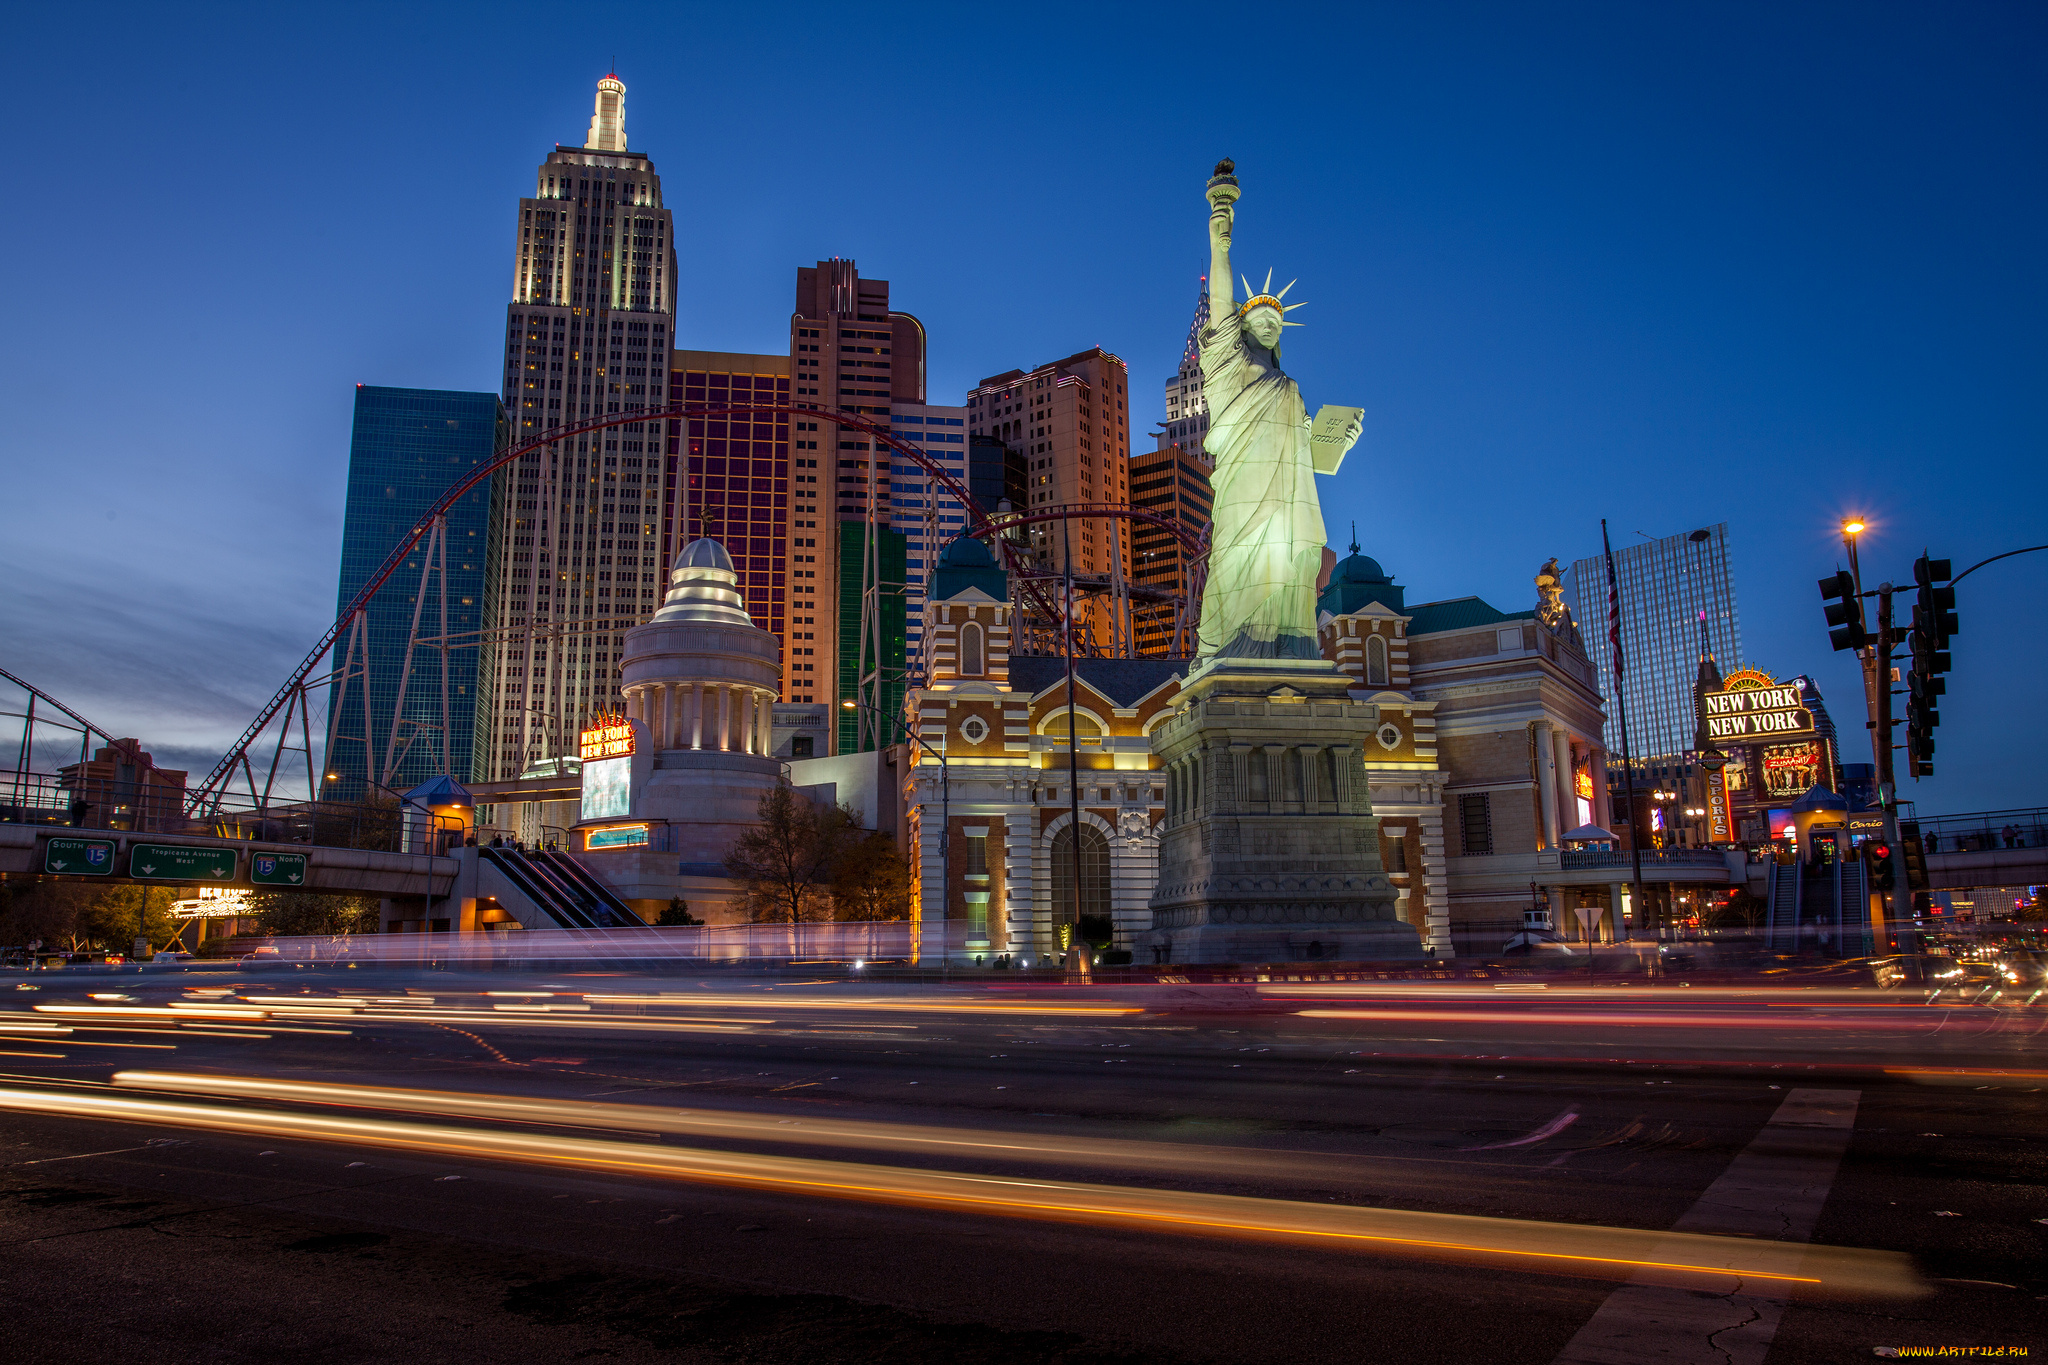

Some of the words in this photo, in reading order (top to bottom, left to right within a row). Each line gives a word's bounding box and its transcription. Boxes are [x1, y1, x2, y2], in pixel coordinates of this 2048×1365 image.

[1706, 693, 1745, 714] NEW
[1748, 688, 1798, 709] YORK
[1708, 716, 1747, 736] NEW
[1751, 711, 1801, 732] YORK
[581, 729, 603, 745] NEW
[603, 724, 630, 741] YORK
[581, 743, 603, 759] NEW
[603, 739, 630, 755] YORK
[1770, 755, 1811, 767] ZUMANITY
[1708, 773, 1727, 835] SPORTS
[53, 841, 84, 849] SOUTH
[90, 849, 105, 861] 15
[151, 848, 190, 856] Tropicana
[260, 861, 272, 872] 15
